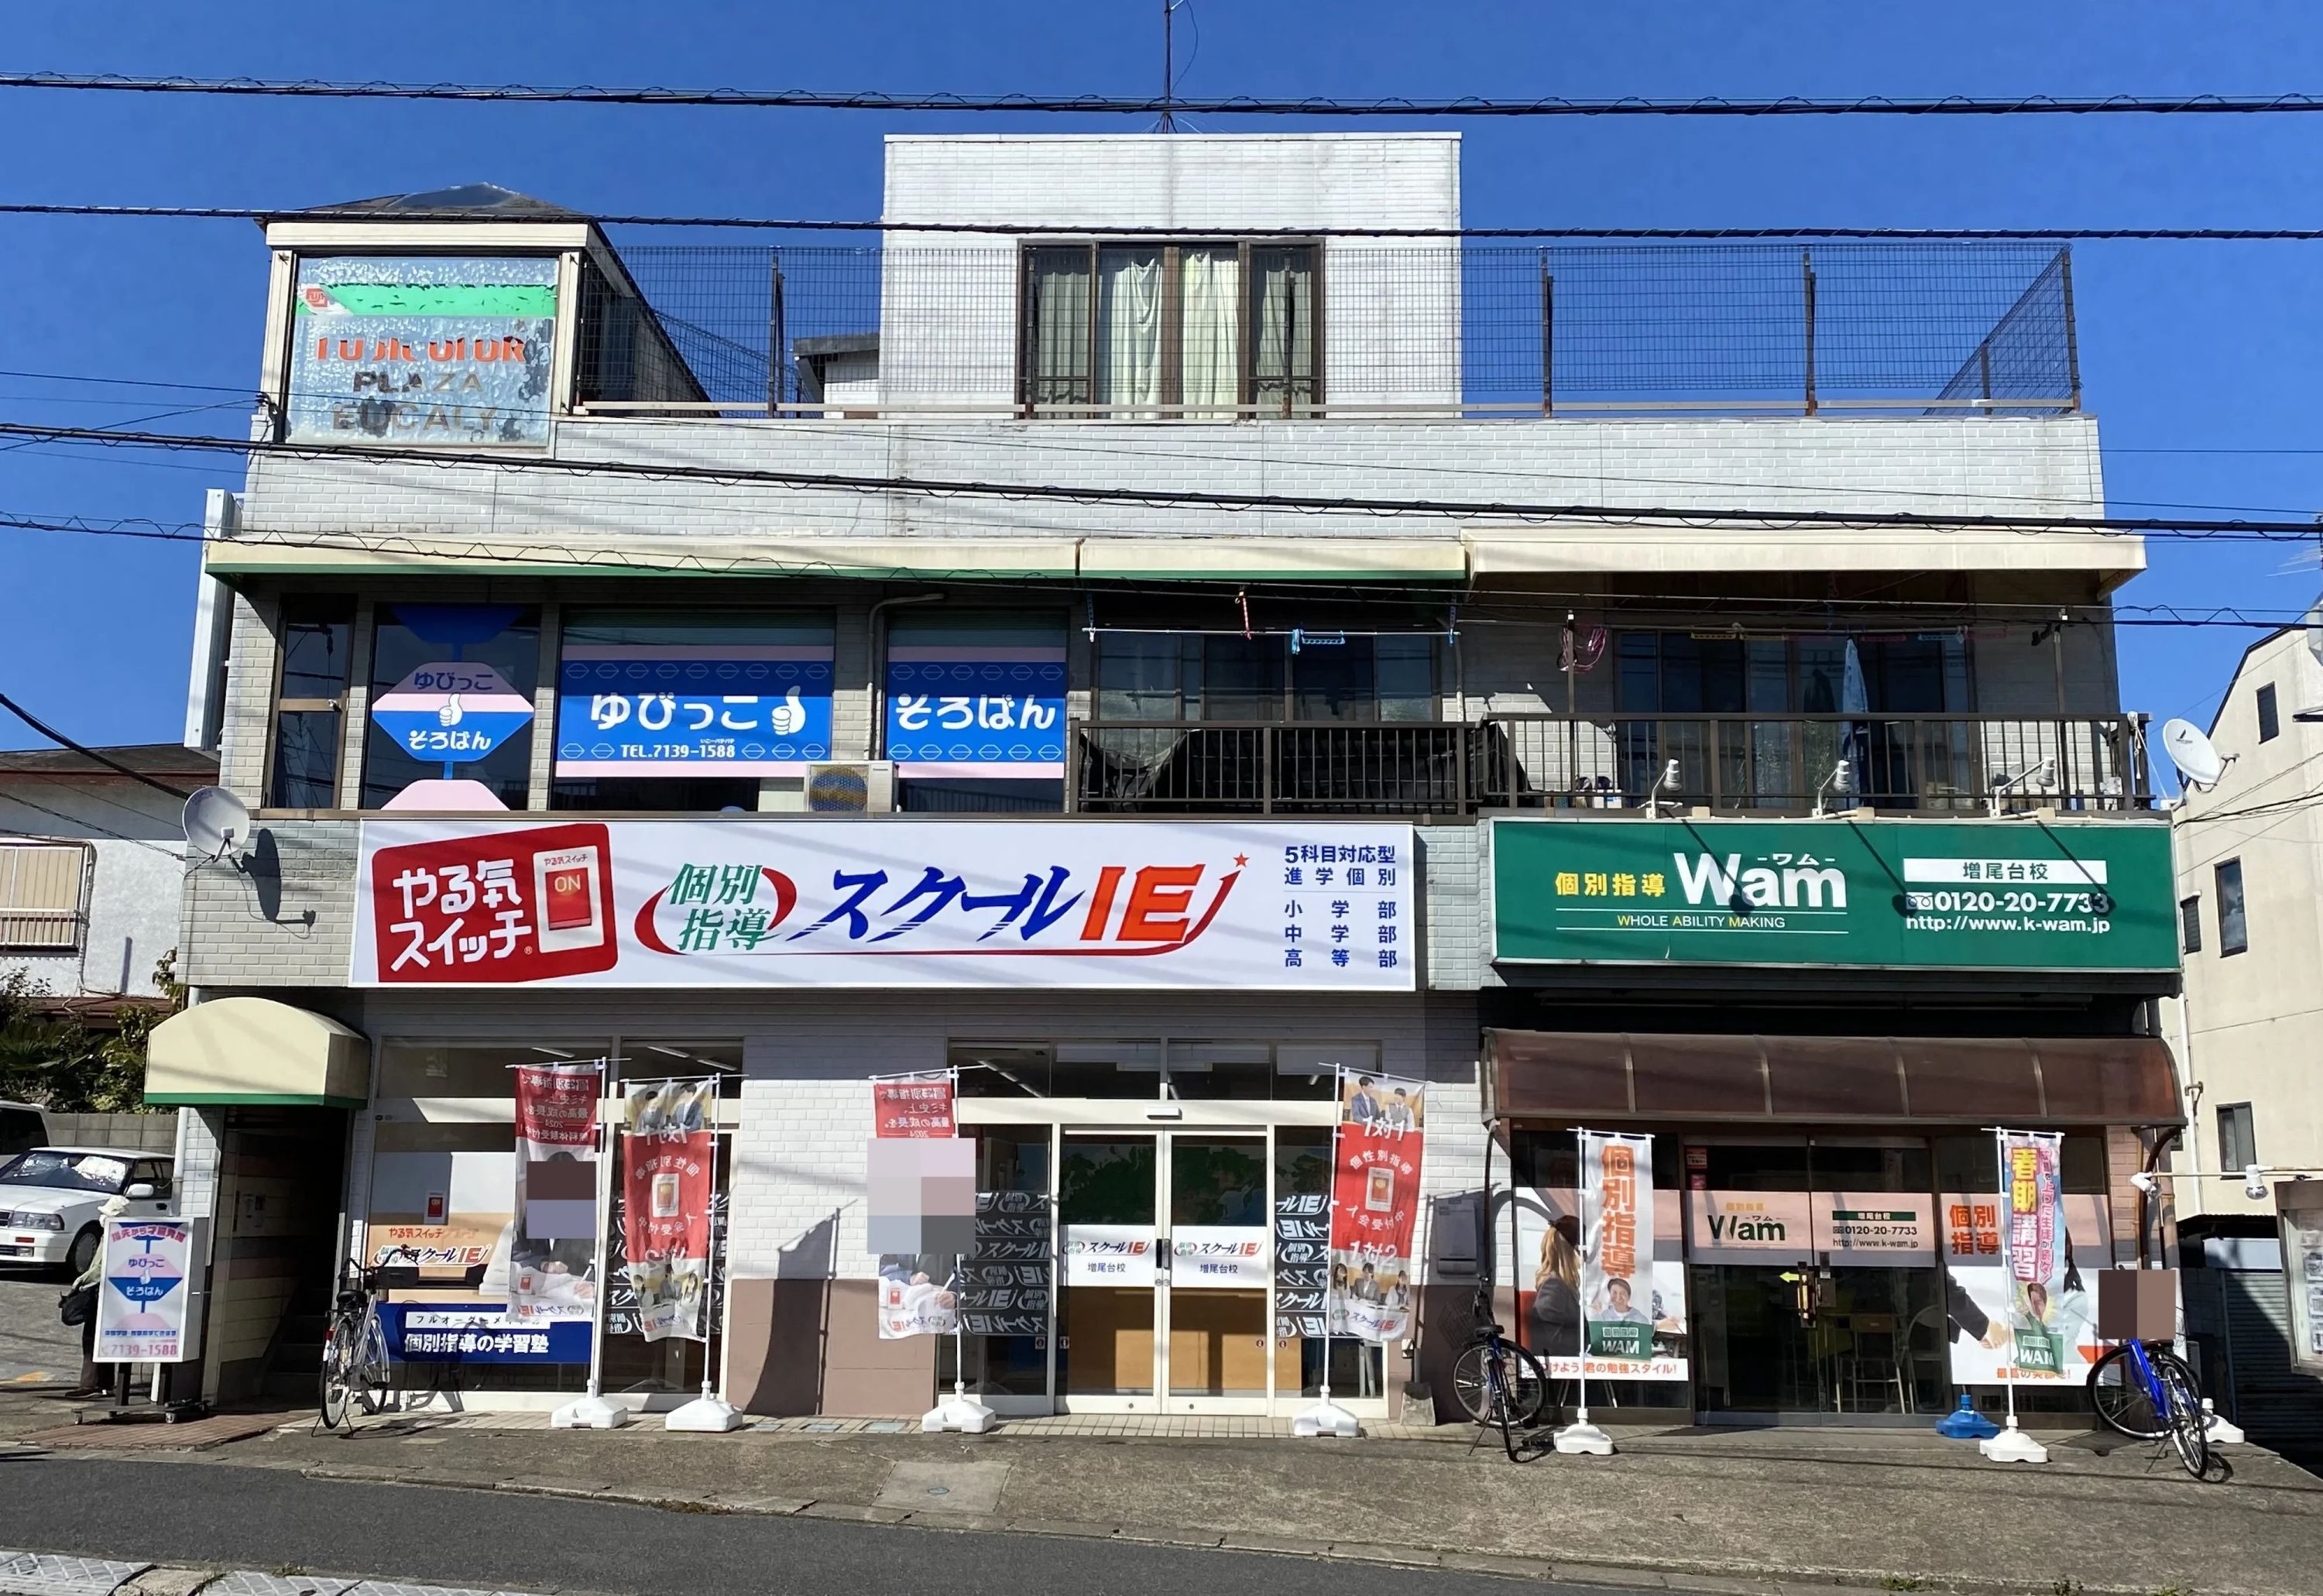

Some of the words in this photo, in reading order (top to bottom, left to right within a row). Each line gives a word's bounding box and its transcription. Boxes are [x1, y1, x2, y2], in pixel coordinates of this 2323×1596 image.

[353, 371, 484, 393] PLAZA
[413, 671, 493, 691] ゆびっこ
[590, 692, 759, 730] ゆびっこ
[895, 694, 1056, 729] そろばん
[409, 730, 492, 750] そろばん
[544, 853, 588, 866] やる気スイッチ
[1285, 844, 1396, 864] 5科目対応型
[1284, 867, 1396, 887] 進学個別
[1673, 853, 1848, 908] Wam
[1962, 862, 2049, 880] 増尾台校
[393, 859, 522, 918] やる気
[554, 874, 581, 892] ON
[668, 863, 763, 905] 個別
[1555, 873, 1666, 898] 個別指導
[1284, 899, 1397, 919] 小学部
[1934, 891, 2110, 913] 0120-20-7733
[677, 908, 776, 952] 指導
[1618, 915, 1669, 927] WHOLE
[1673, 915, 1725, 928] ABILITY
[1729, 916, 1786, 928] MAKING
[1906, 915, 2111, 934] http://www.k-wam.jp
[390, 909, 532, 972] スイッチ
[1285, 924, 1397, 944] 中学部
[1284, 949, 1398, 968] 高等部
[1363, 1116, 1405, 1141] 1対1
[1601, 1145, 1636, 1279] 個別指導
[1950, 1205, 1996, 1228] 個別
[2011, 1147, 2039, 1282] 春期講習
[1707, 1214, 1786, 1241] Wam
[1844, 1227, 1918, 1236] 0120-20-7733
[1833, 1238, 1919, 1249] http://www.k-wam.jp
[1951, 1232, 2000, 1255] 指導
[128, 1258, 165, 1268] ゆびっこ
[1350, 1241, 1398, 1268] 1対2
[1087, 1262, 1126, 1272] 増尾台校
[1200, 1263, 1238, 1274] 増尾台校
[125, 1285, 164, 1296] そろばん
[111, 1344, 177, 1356] 7139-1588
[404, 1333, 550, 1354] 個別指導の学習塾
[1602, 1340, 1640, 1354] WAM
